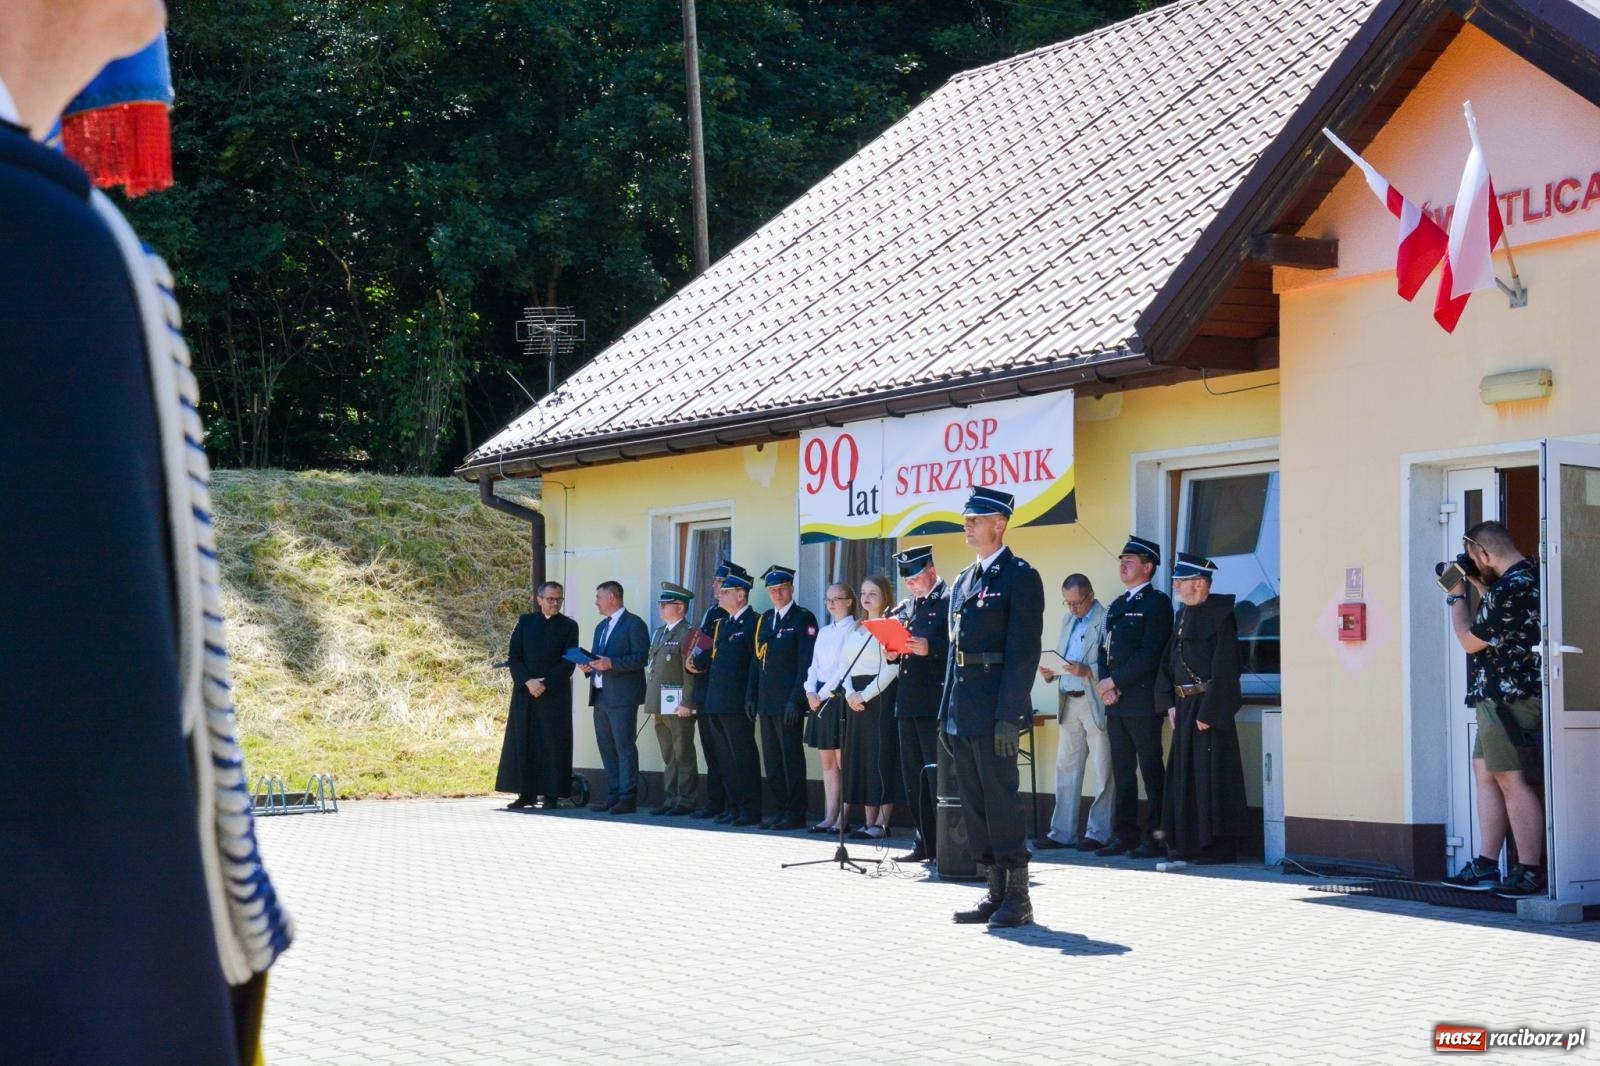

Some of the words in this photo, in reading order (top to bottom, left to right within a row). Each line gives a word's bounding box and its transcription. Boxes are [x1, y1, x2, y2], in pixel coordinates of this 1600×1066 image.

[944, 417, 998, 453] OSP
[804, 433, 859, 495] 90
[895, 448, 1056, 496] STRZYBNIK
[847, 480, 879, 517] lat
